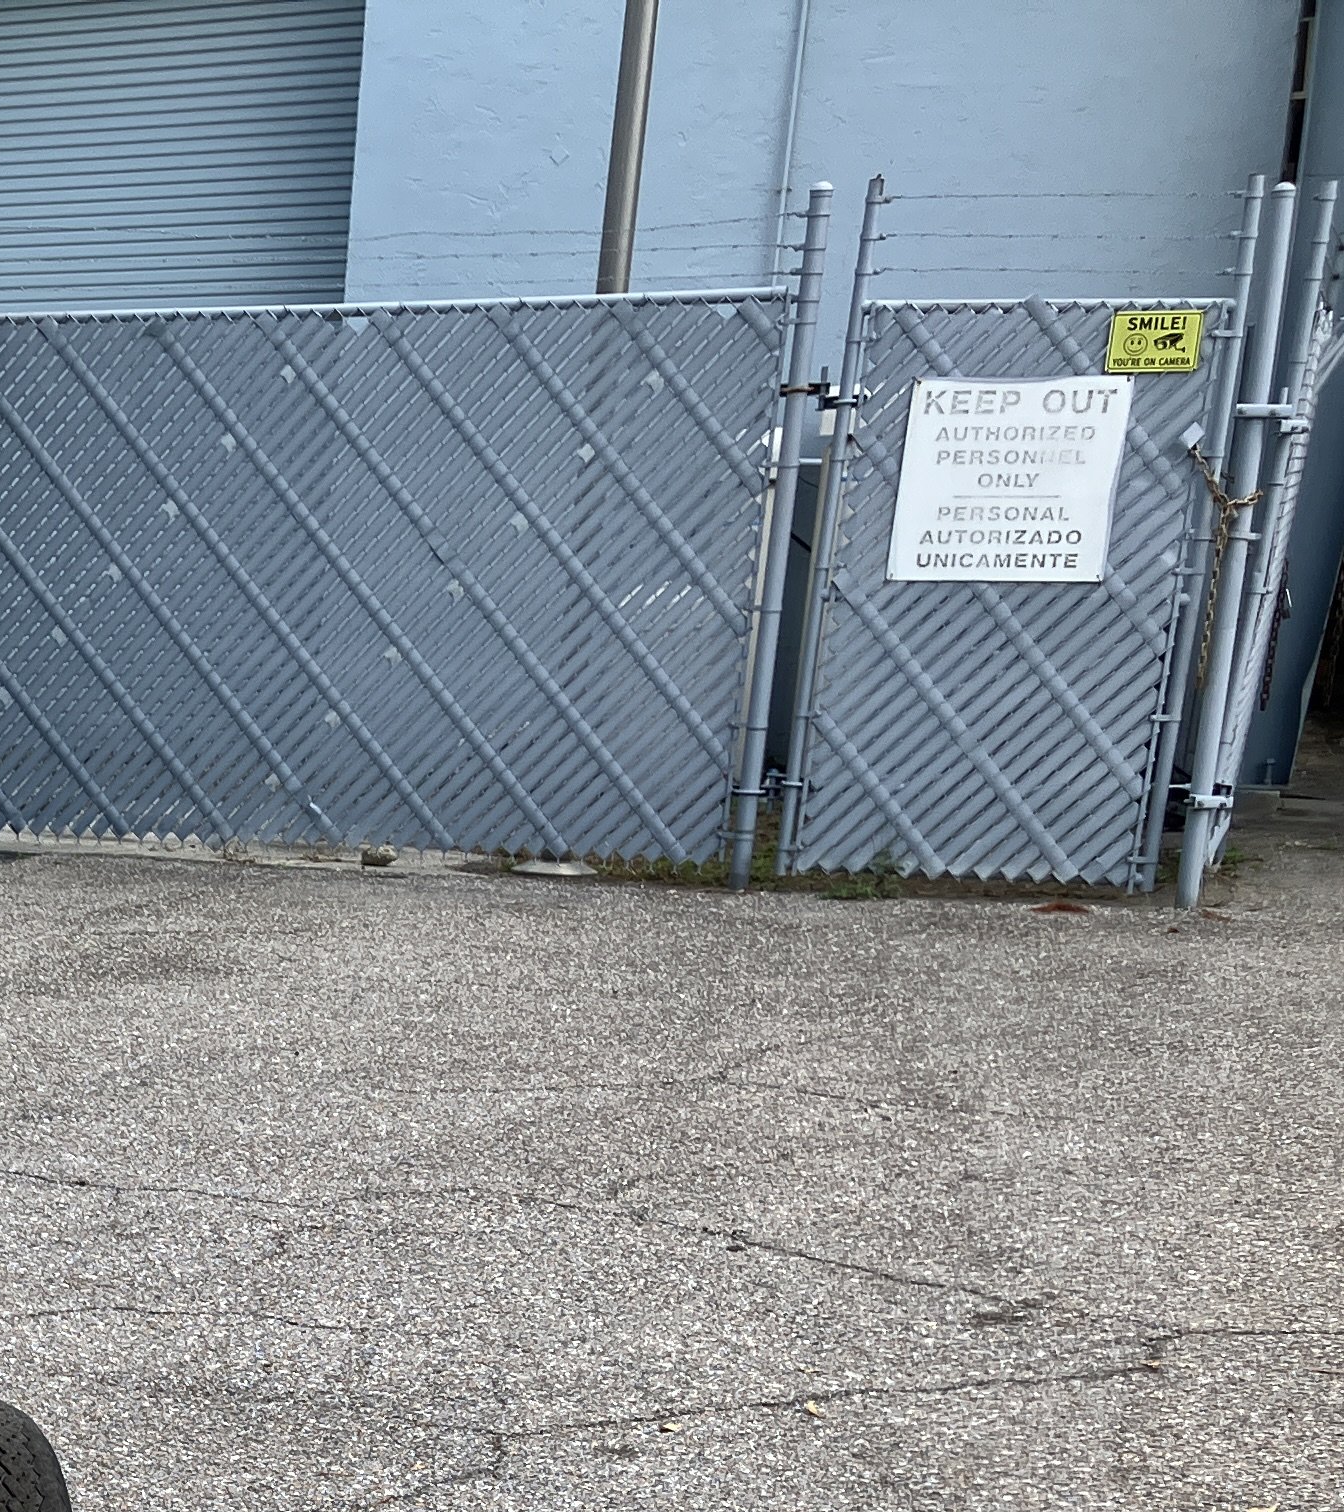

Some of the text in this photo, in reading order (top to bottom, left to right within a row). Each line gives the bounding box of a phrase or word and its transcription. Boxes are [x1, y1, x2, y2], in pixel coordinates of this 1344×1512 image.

[1127, 316, 1187, 331] SMILE!
[1113, 357, 1190, 367] YOU'RE ON CAMERA
[923, 388, 1118, 415] KEEP OUT
[935, 426, 1097, 442] AUTHORIZED
[936, 449, 1087, 465] PERSONNEL
[977, 473, 1040, 488] ONLY
[937, 506, 1070, 521] PERSONAL
[919, 530, 1082, 545] AUTORIZADO
[916, 553, 1078, 569] UNICAMENTE
